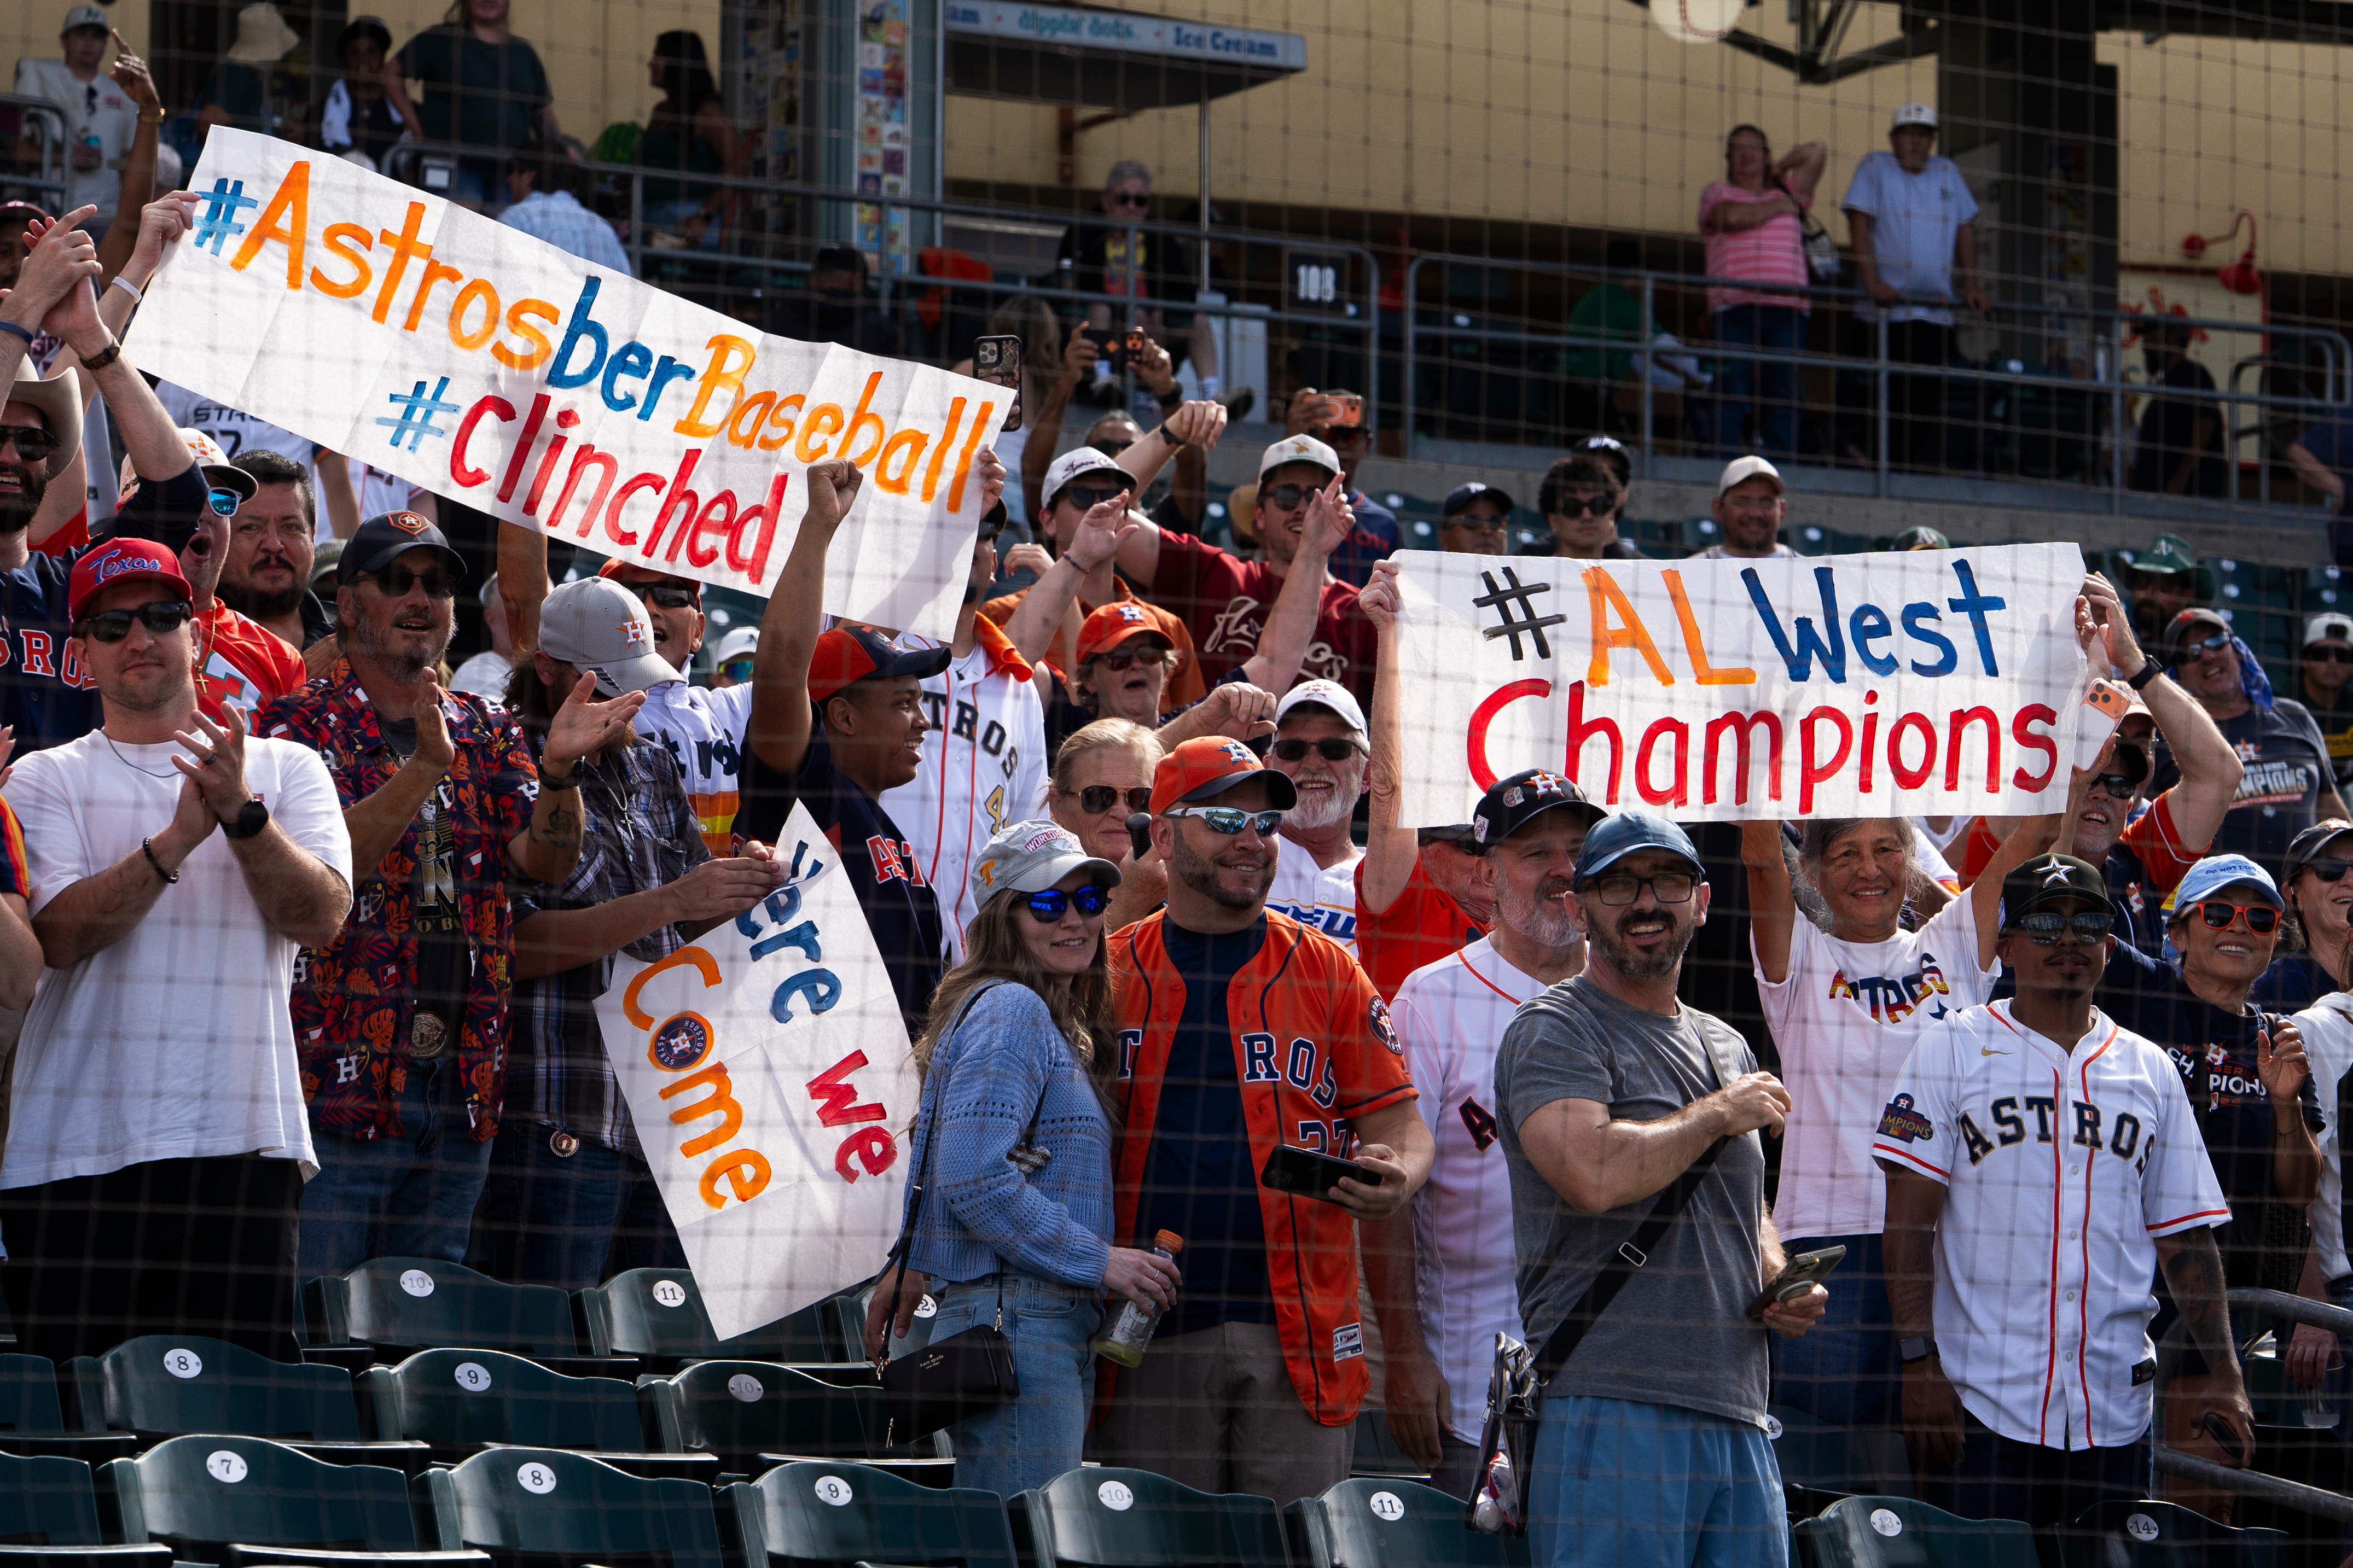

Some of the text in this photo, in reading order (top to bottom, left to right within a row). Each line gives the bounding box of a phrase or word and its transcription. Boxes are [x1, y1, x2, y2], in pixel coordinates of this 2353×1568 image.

[1173, 27, 1204, 48] Ice
[1210, 31, 1277, 57] Cream
[375, 376, 789, 585] #Clinched
[89, 549, 161, 585] Texas
[1467, 678, 2058, 815] Champions
[1025, 830, 1057, 853] WORLD
[979, 859, 995, 887] T
[684, 1021, 704, 1053] HOUSTON
[658, 1035, 675, 1065] ASTROS
[623, 946, 771, 1210] Come
[1881, 1114, 1931, 1138] AMPIONS
[409, 1277, 425, 1289] 10
[660, 1287, 678, 1301] 11
[177, 1356, 189, 1371] 8
[467, 1369, 479, 1384] 9
[737, 1382, 754, 1394] 10
[220, 1459, 231, 1474] 7
[531, 1470, 543, 1486] 8
[827, 1483, 839, 1499] 9
[1107, 1489, 1124, 1502] 10
[1378, 1499, 1397, 1513] 11
[2133, 1520, 2152, 1535] 14
